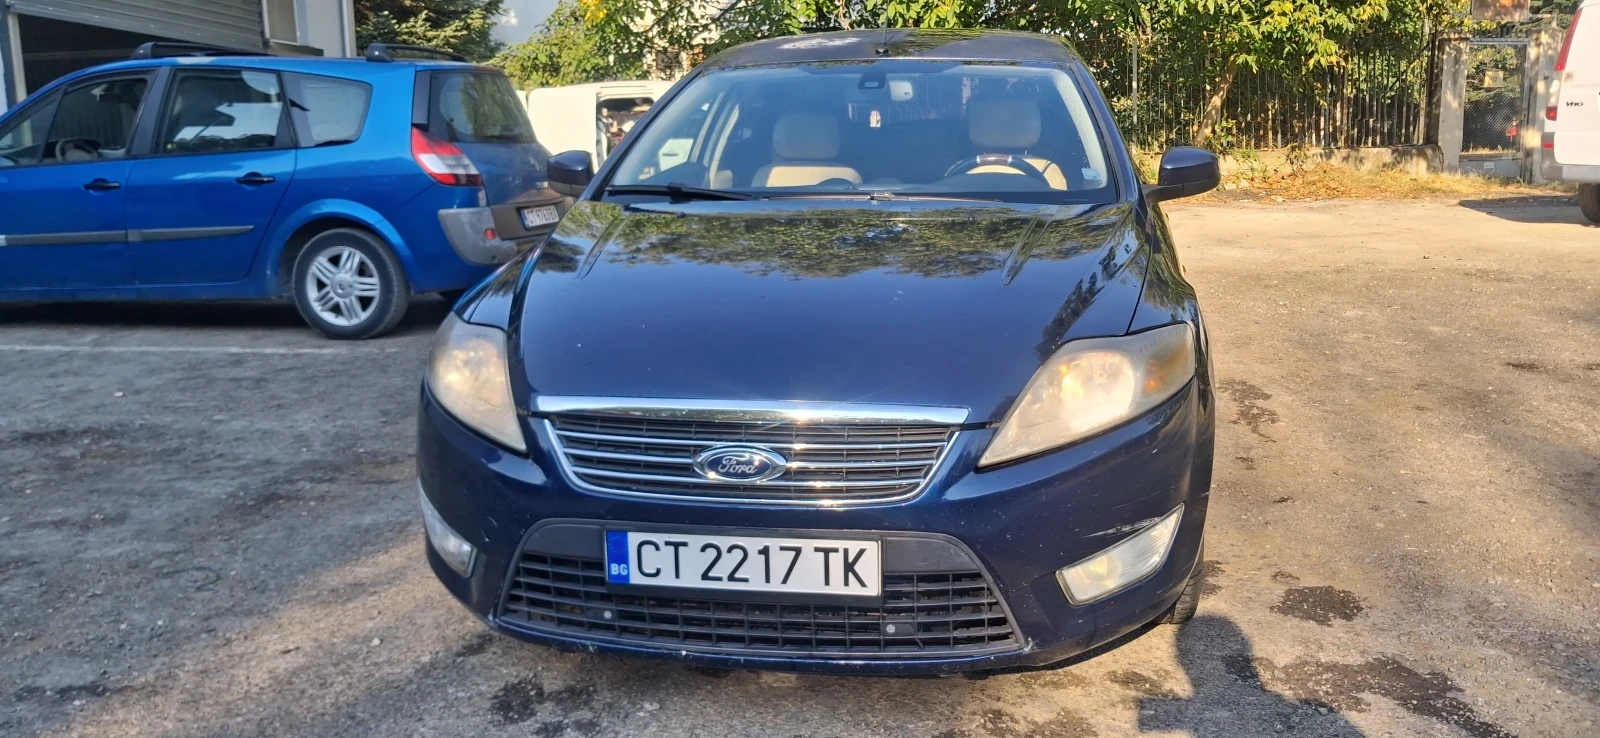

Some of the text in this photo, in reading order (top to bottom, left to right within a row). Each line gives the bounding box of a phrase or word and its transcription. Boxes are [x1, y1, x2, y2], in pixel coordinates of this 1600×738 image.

[718, 453, 758, 474] Ford
[611, 563, 629, 576] BG
[636, 539, 869, 588] CT 2217 TK
